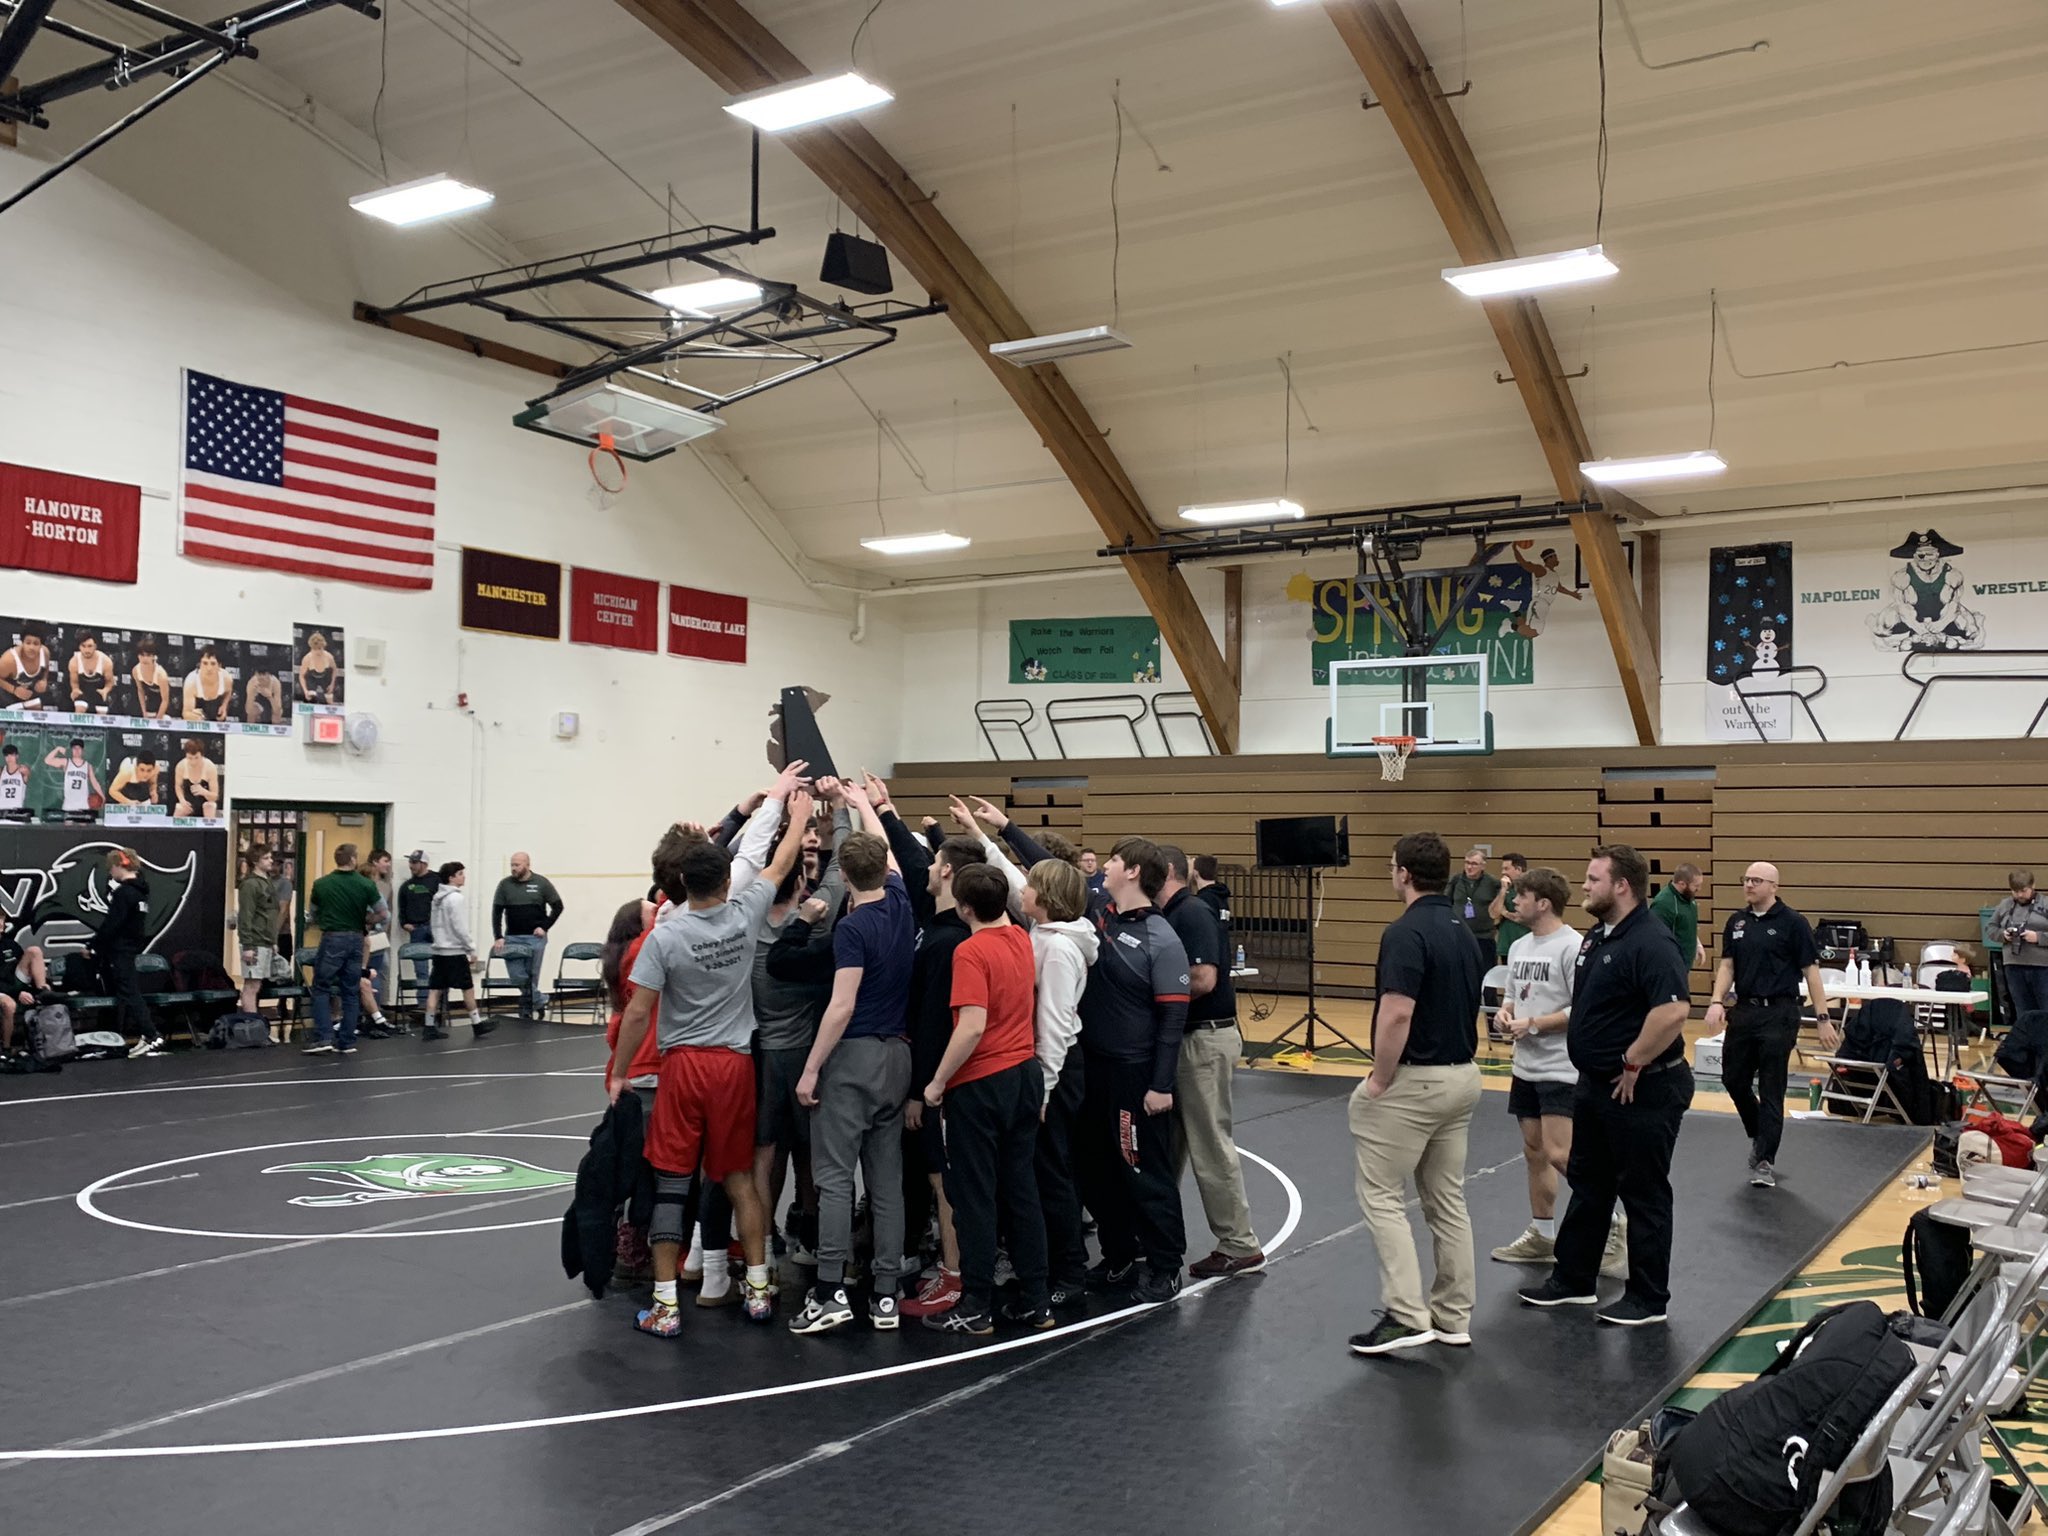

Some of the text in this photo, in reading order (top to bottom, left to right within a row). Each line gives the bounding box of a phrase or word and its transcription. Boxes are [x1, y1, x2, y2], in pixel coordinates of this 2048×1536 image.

[24, 497, 103, 524] HANOVER
[477, 582, 547, 606] MANCHESTER
[1544, 584, 1558, 596] 20
[1800, 580, 2048, 603] NAPOLEON WRESTLE
[593, 592, 638, 611] MICHIGAN
[1313, 577, 1484, 645] SPRNG
[596, 610, 634, 627] CENTER
[670, 612, 746, 636] VANDERCOOK LAKE
[1060, 629, 1073, 637] the
[1079, 627, 1114, 636] Warriors
[1037, 646, 1062, 656] Watch
[1052, 669, 1083, 680] CLASS
[1085, 671, 1097, 680] OF
[1721, 703, 1770, 715] out the
[1724, 719, 1777, 730] Warrors!
[72, 779, 82, 790] 23
[5, 787, 16, 799] 22
[695, 953, 714, 963] Sam
[1513, 961, 1550, 981] CLINTON
